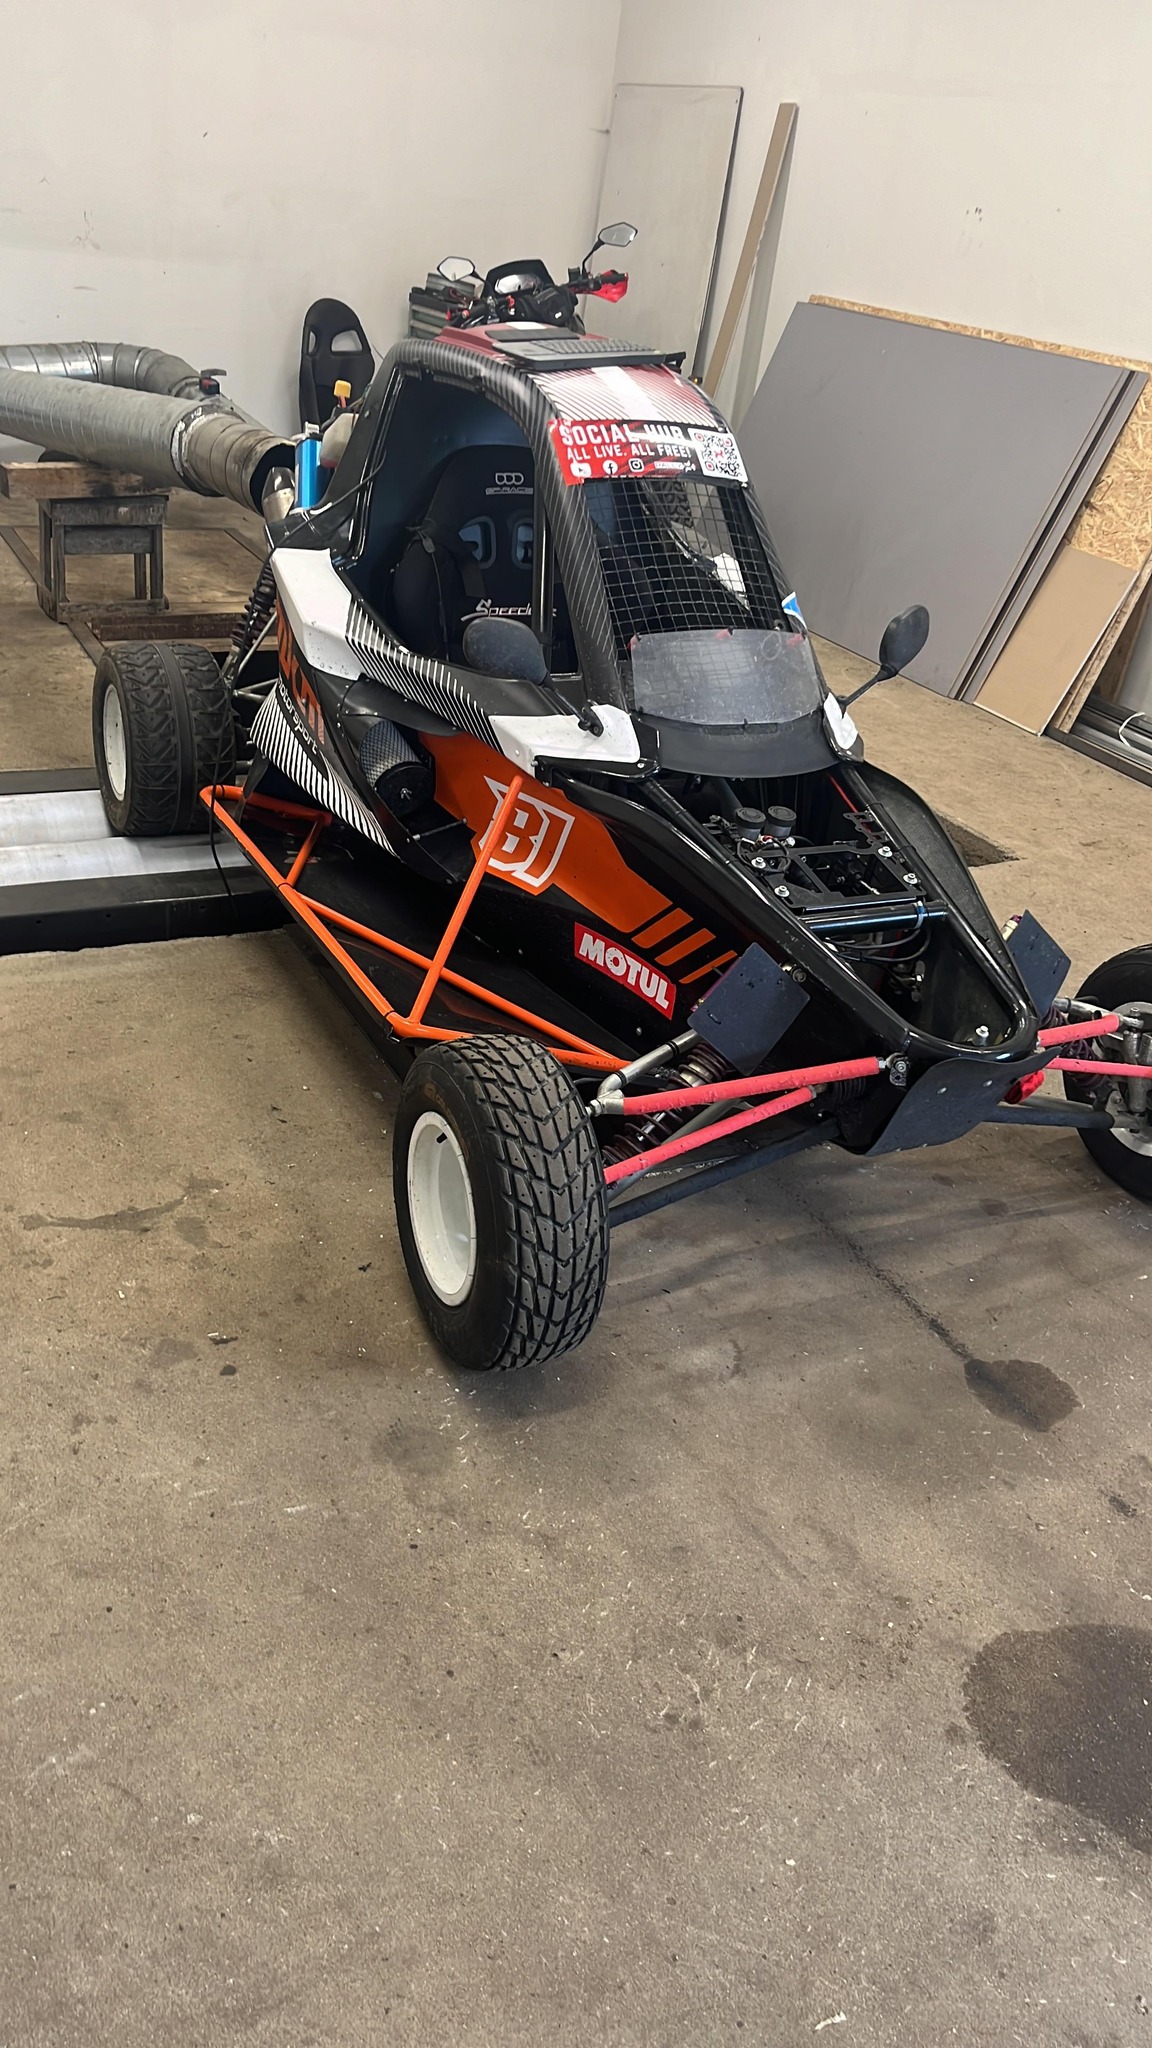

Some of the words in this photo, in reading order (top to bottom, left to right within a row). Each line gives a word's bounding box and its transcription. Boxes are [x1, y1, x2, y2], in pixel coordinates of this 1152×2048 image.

[559, 423, 639, 447] SOCIAL
[644, 424, 686, 443] HUB
[567, 446, 591, 461] ALL
[594, 444, 628, 459] LIVE.
[631, 443, 655, 457] ALL
[656, 444, 692, 459] FREE!
[578, 932, 671, 1010] MOTUL
